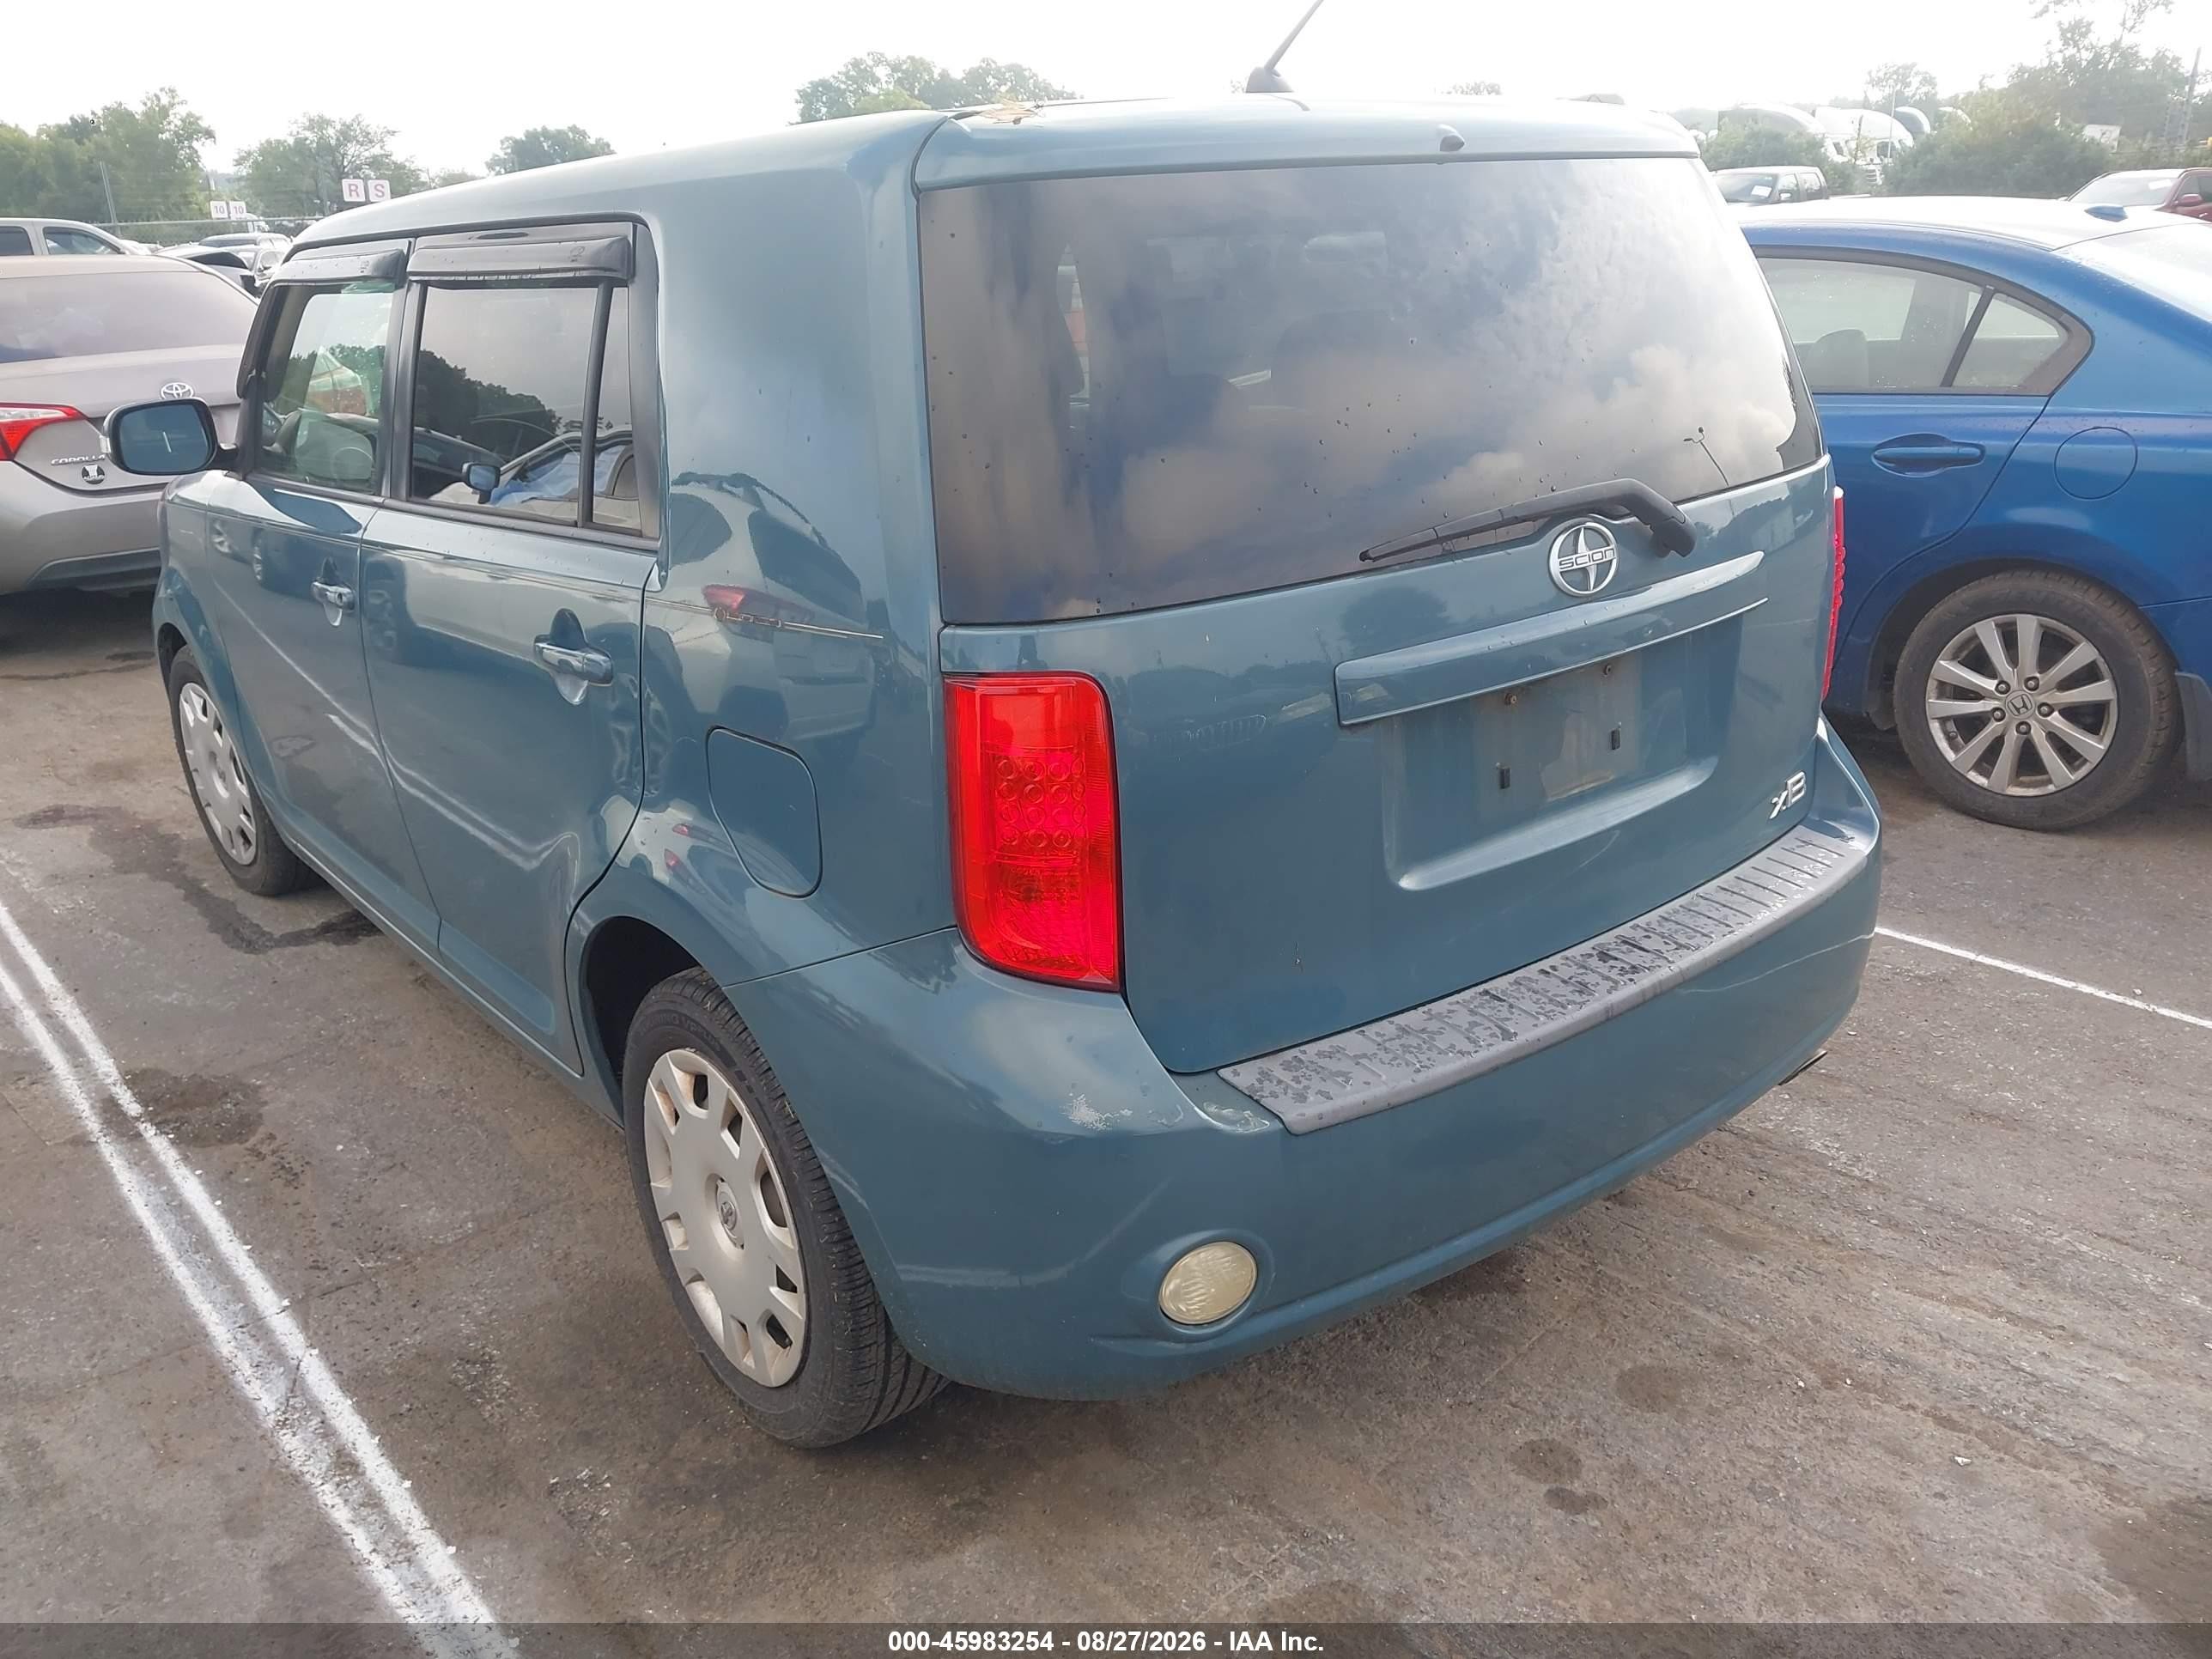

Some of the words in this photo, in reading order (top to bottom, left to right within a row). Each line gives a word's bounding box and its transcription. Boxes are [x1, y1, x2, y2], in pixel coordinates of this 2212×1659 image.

[348, 184, 360, 198] R
[374, 184, 386, 198] S
[213, 205, 225, 215] 10
[233, 206, 244, 216] 10
[1559, 548, 1615, 570] SCION
[1768, 770, 1807, 819] xB
